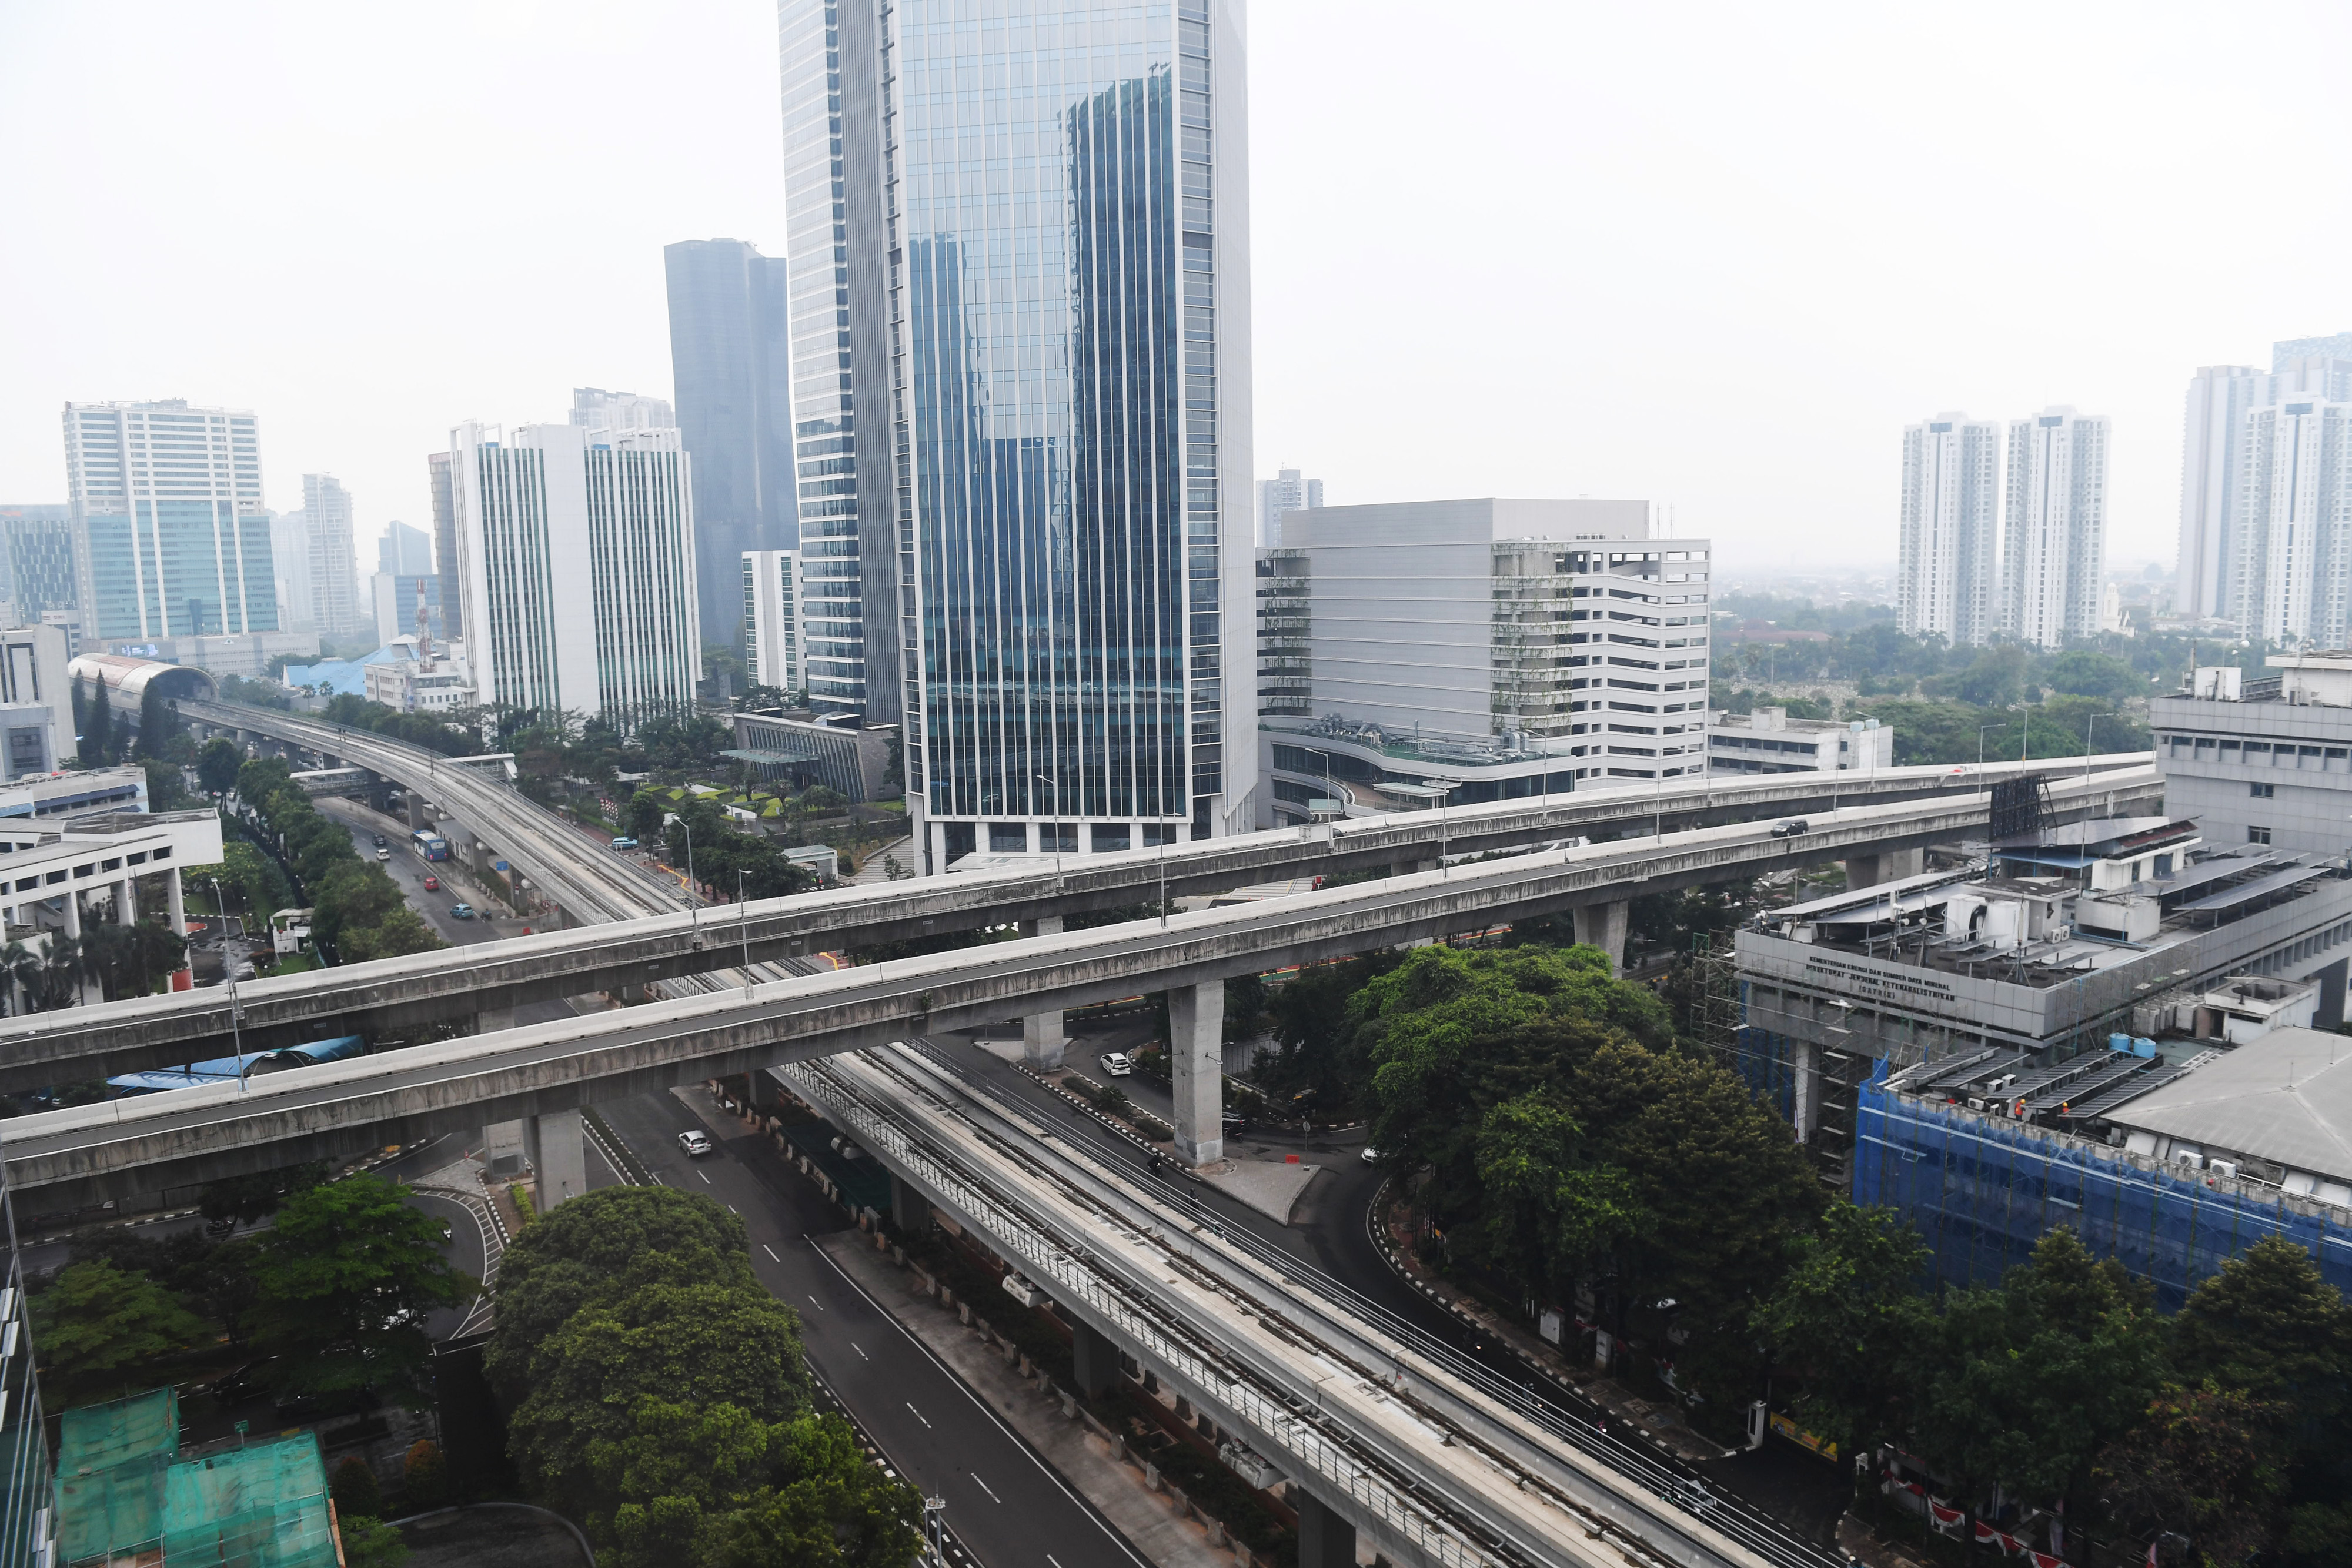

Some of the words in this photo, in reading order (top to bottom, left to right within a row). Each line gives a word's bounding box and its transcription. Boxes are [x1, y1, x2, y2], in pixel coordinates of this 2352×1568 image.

[1810, 956, 1846, 968] KEMENTERIAN
[1847, 964, 1867, 972] ENERGI
[1883, 972, 1906, 981] SUMBER
[1908, 977, 1922, 985] DAYA
[1924, 980, 1950, 991] MINERAL
